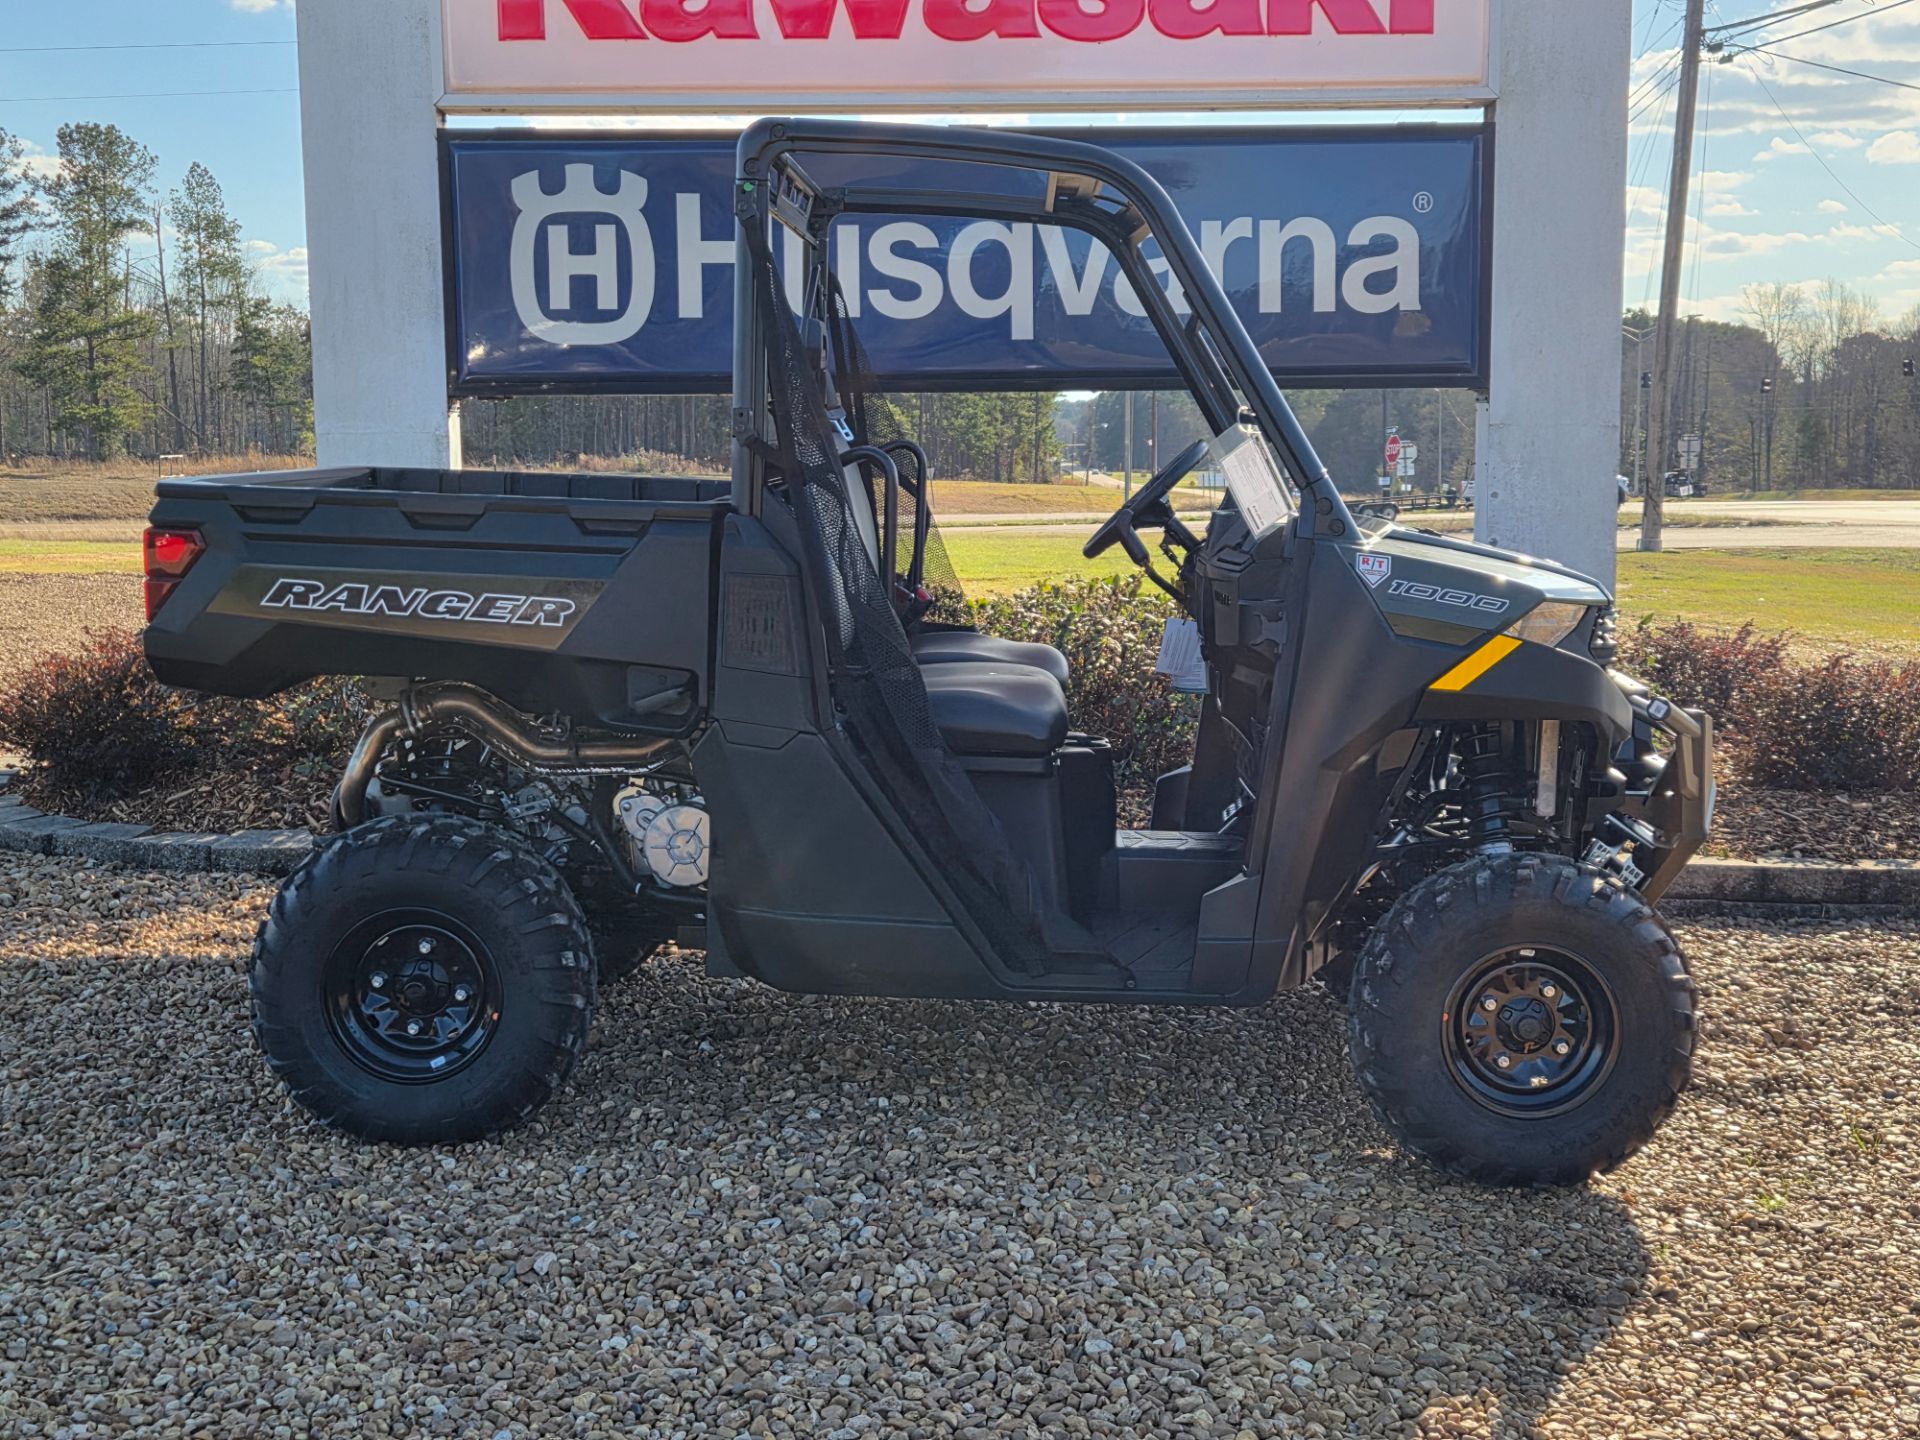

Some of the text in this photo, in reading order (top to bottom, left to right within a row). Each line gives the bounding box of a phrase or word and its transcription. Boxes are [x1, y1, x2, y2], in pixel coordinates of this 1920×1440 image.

[676, 192, 1420, 340] Husqvarna
[1385, 443, 1401, 456] STOP
[260, 578, 576, 627] RANGER
[1387, 579, 1510, 613] 1000
